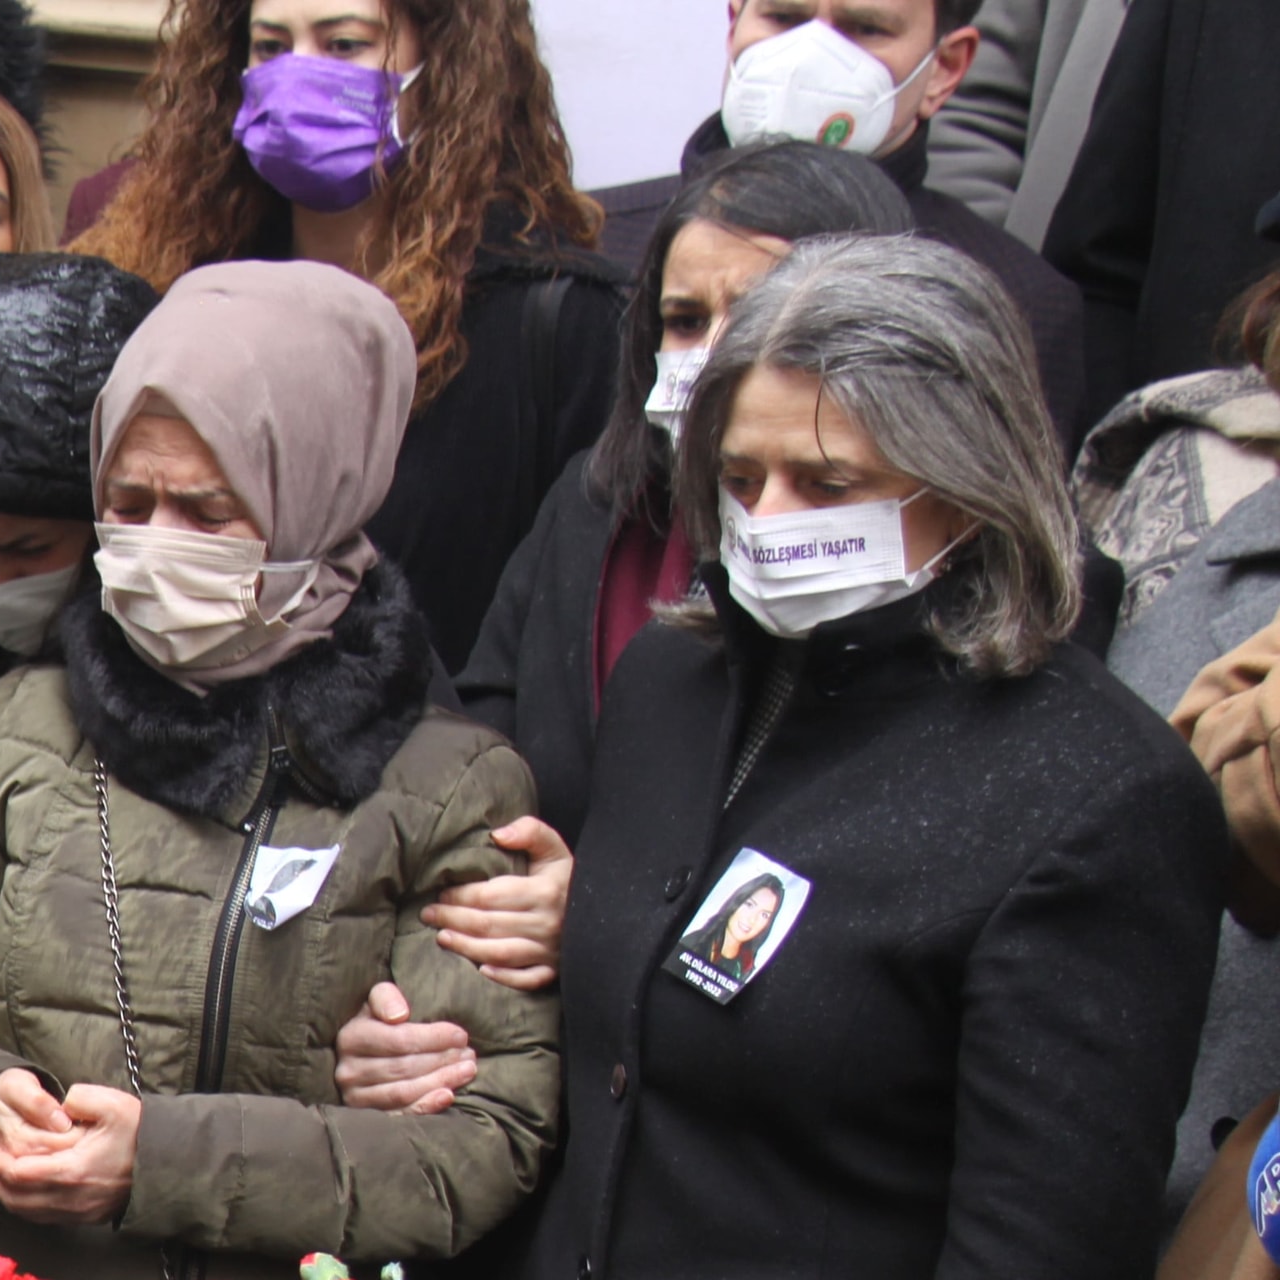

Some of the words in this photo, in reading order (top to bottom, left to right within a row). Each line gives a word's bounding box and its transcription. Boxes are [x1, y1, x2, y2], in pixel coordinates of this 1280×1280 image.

[752, 538, 818, 566] SÖZLEŞMESİ
[820, 537, 866, 560] YAŞATIR
[690, 957, 718, 982] DİLARA
